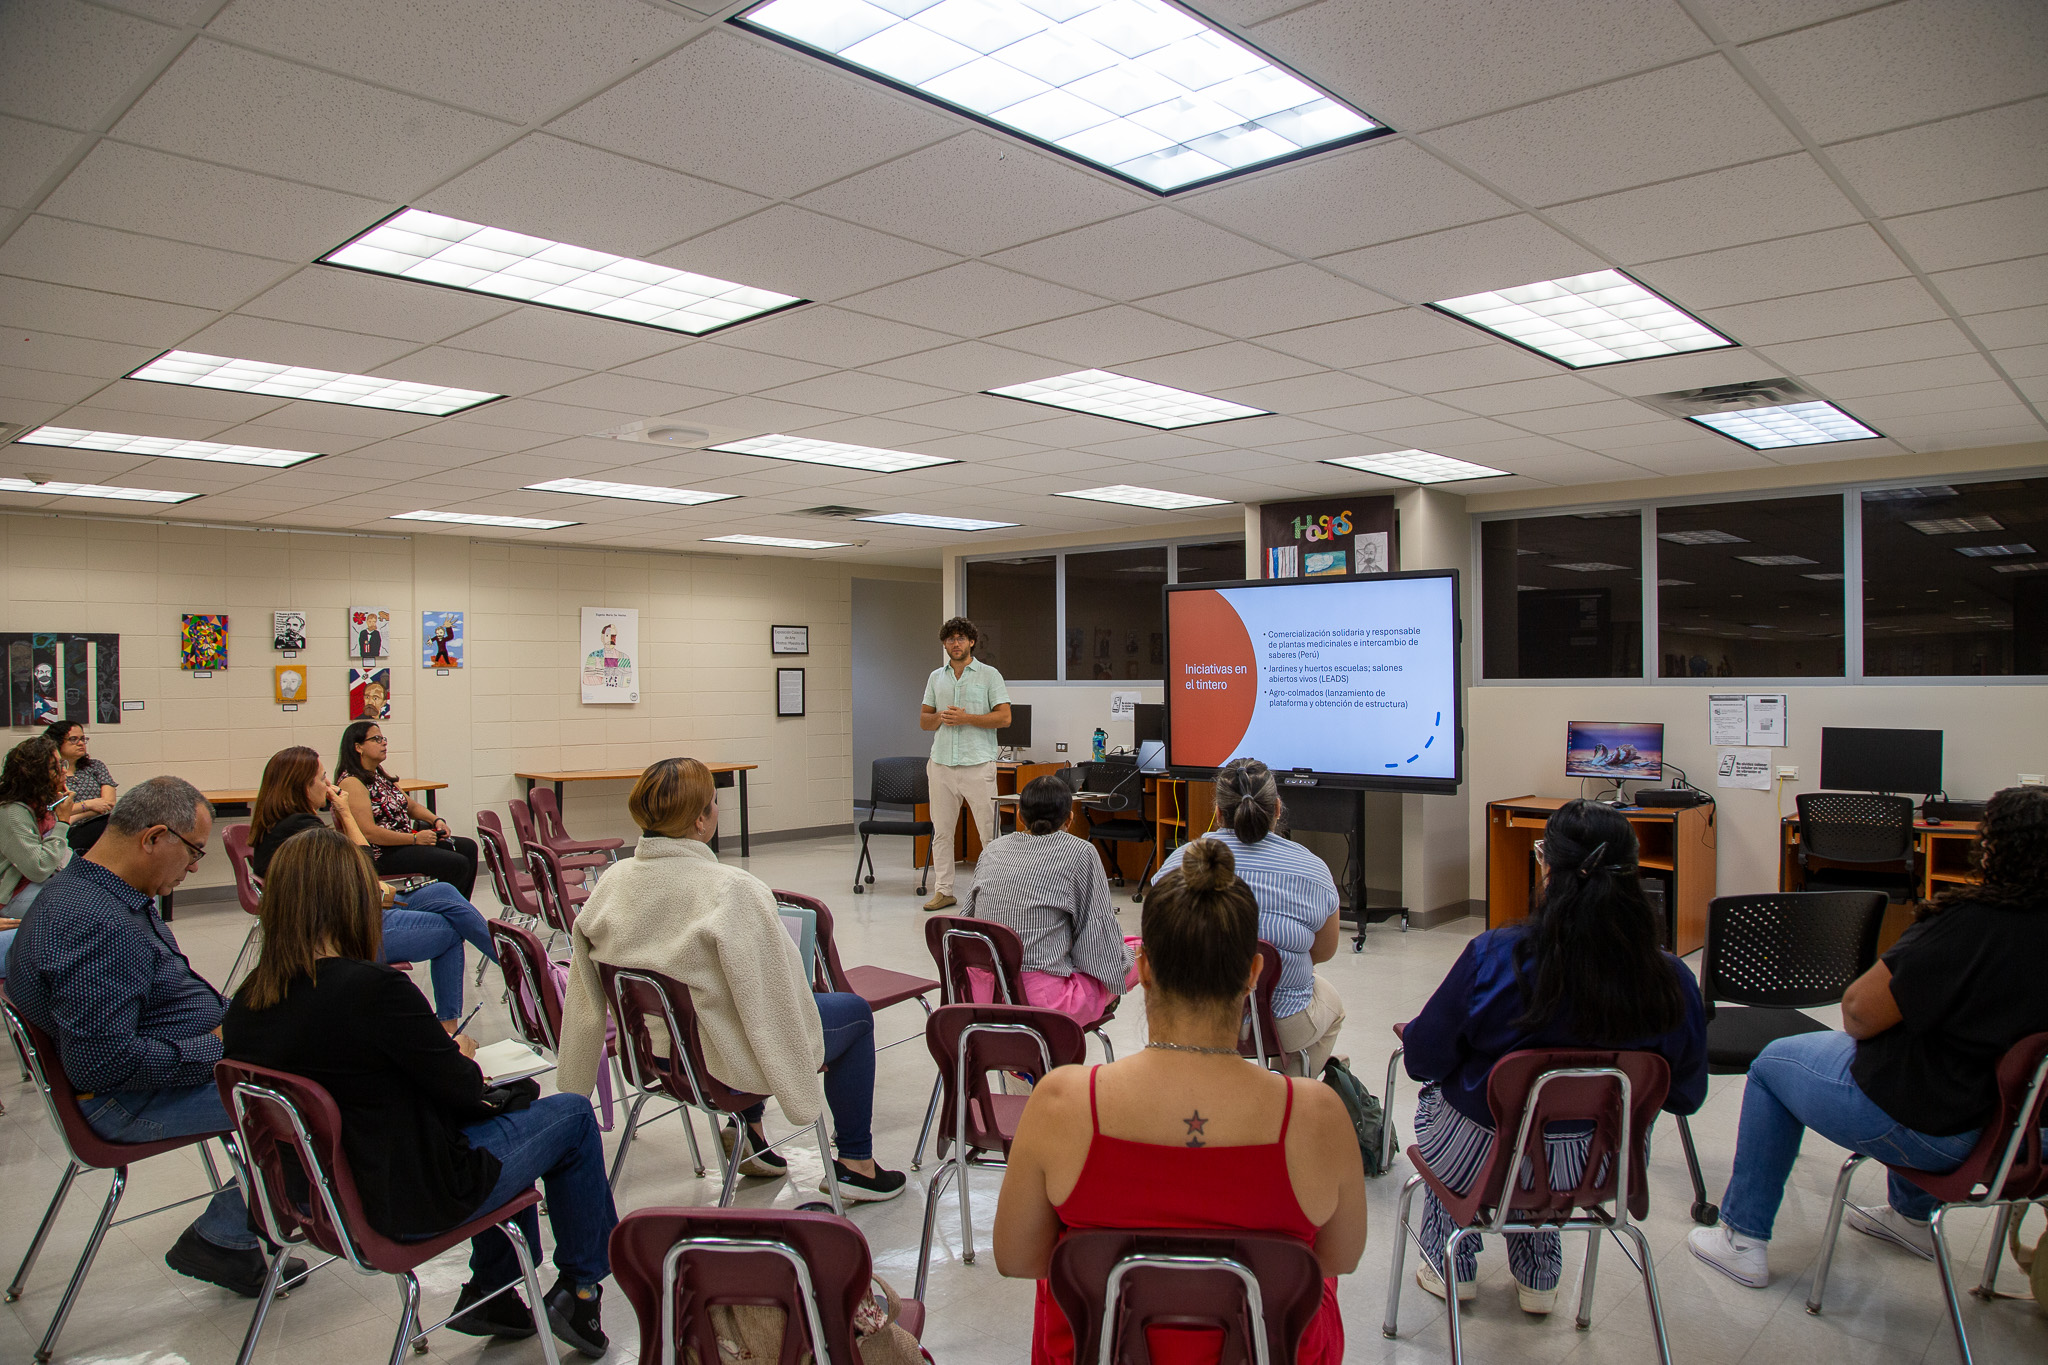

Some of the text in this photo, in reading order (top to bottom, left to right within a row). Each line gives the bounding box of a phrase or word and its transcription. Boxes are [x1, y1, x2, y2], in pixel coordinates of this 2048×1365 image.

[1268, 630, 1330, 639] Comercialización
[1332, 628, 1364, 637] solidaria
[1372, 627, 1421, 637] responsable
[1278, 641, 1306, 650] plantas
[1307, 640, 1352, 648] medicinales
[1408, 638, 1418, 646] de
[1268, 651, 1320, 660] saberes (Perú)
[1185, 664, 1247, 674] Iniciativas en
[1268, 665, 1297, 673] Jardines
[1304, 664, 1333, 672] huertos
[1334, 664, 1371, 673] escuelas;
[1372, 664, 1403, 672] salones
[1185, 679, 1227, 690] el tintero
[1268, 675, 1349, 684] abiertos vivos (LEADS)
[1269, 689, 1385, 697] Agro-colmados (lanzamiento de
[1269, 699, 1308, 707] plataforma
[1315, 699, 1352, 708] obtención
[1365, 700, 1408, 709] estructura)
